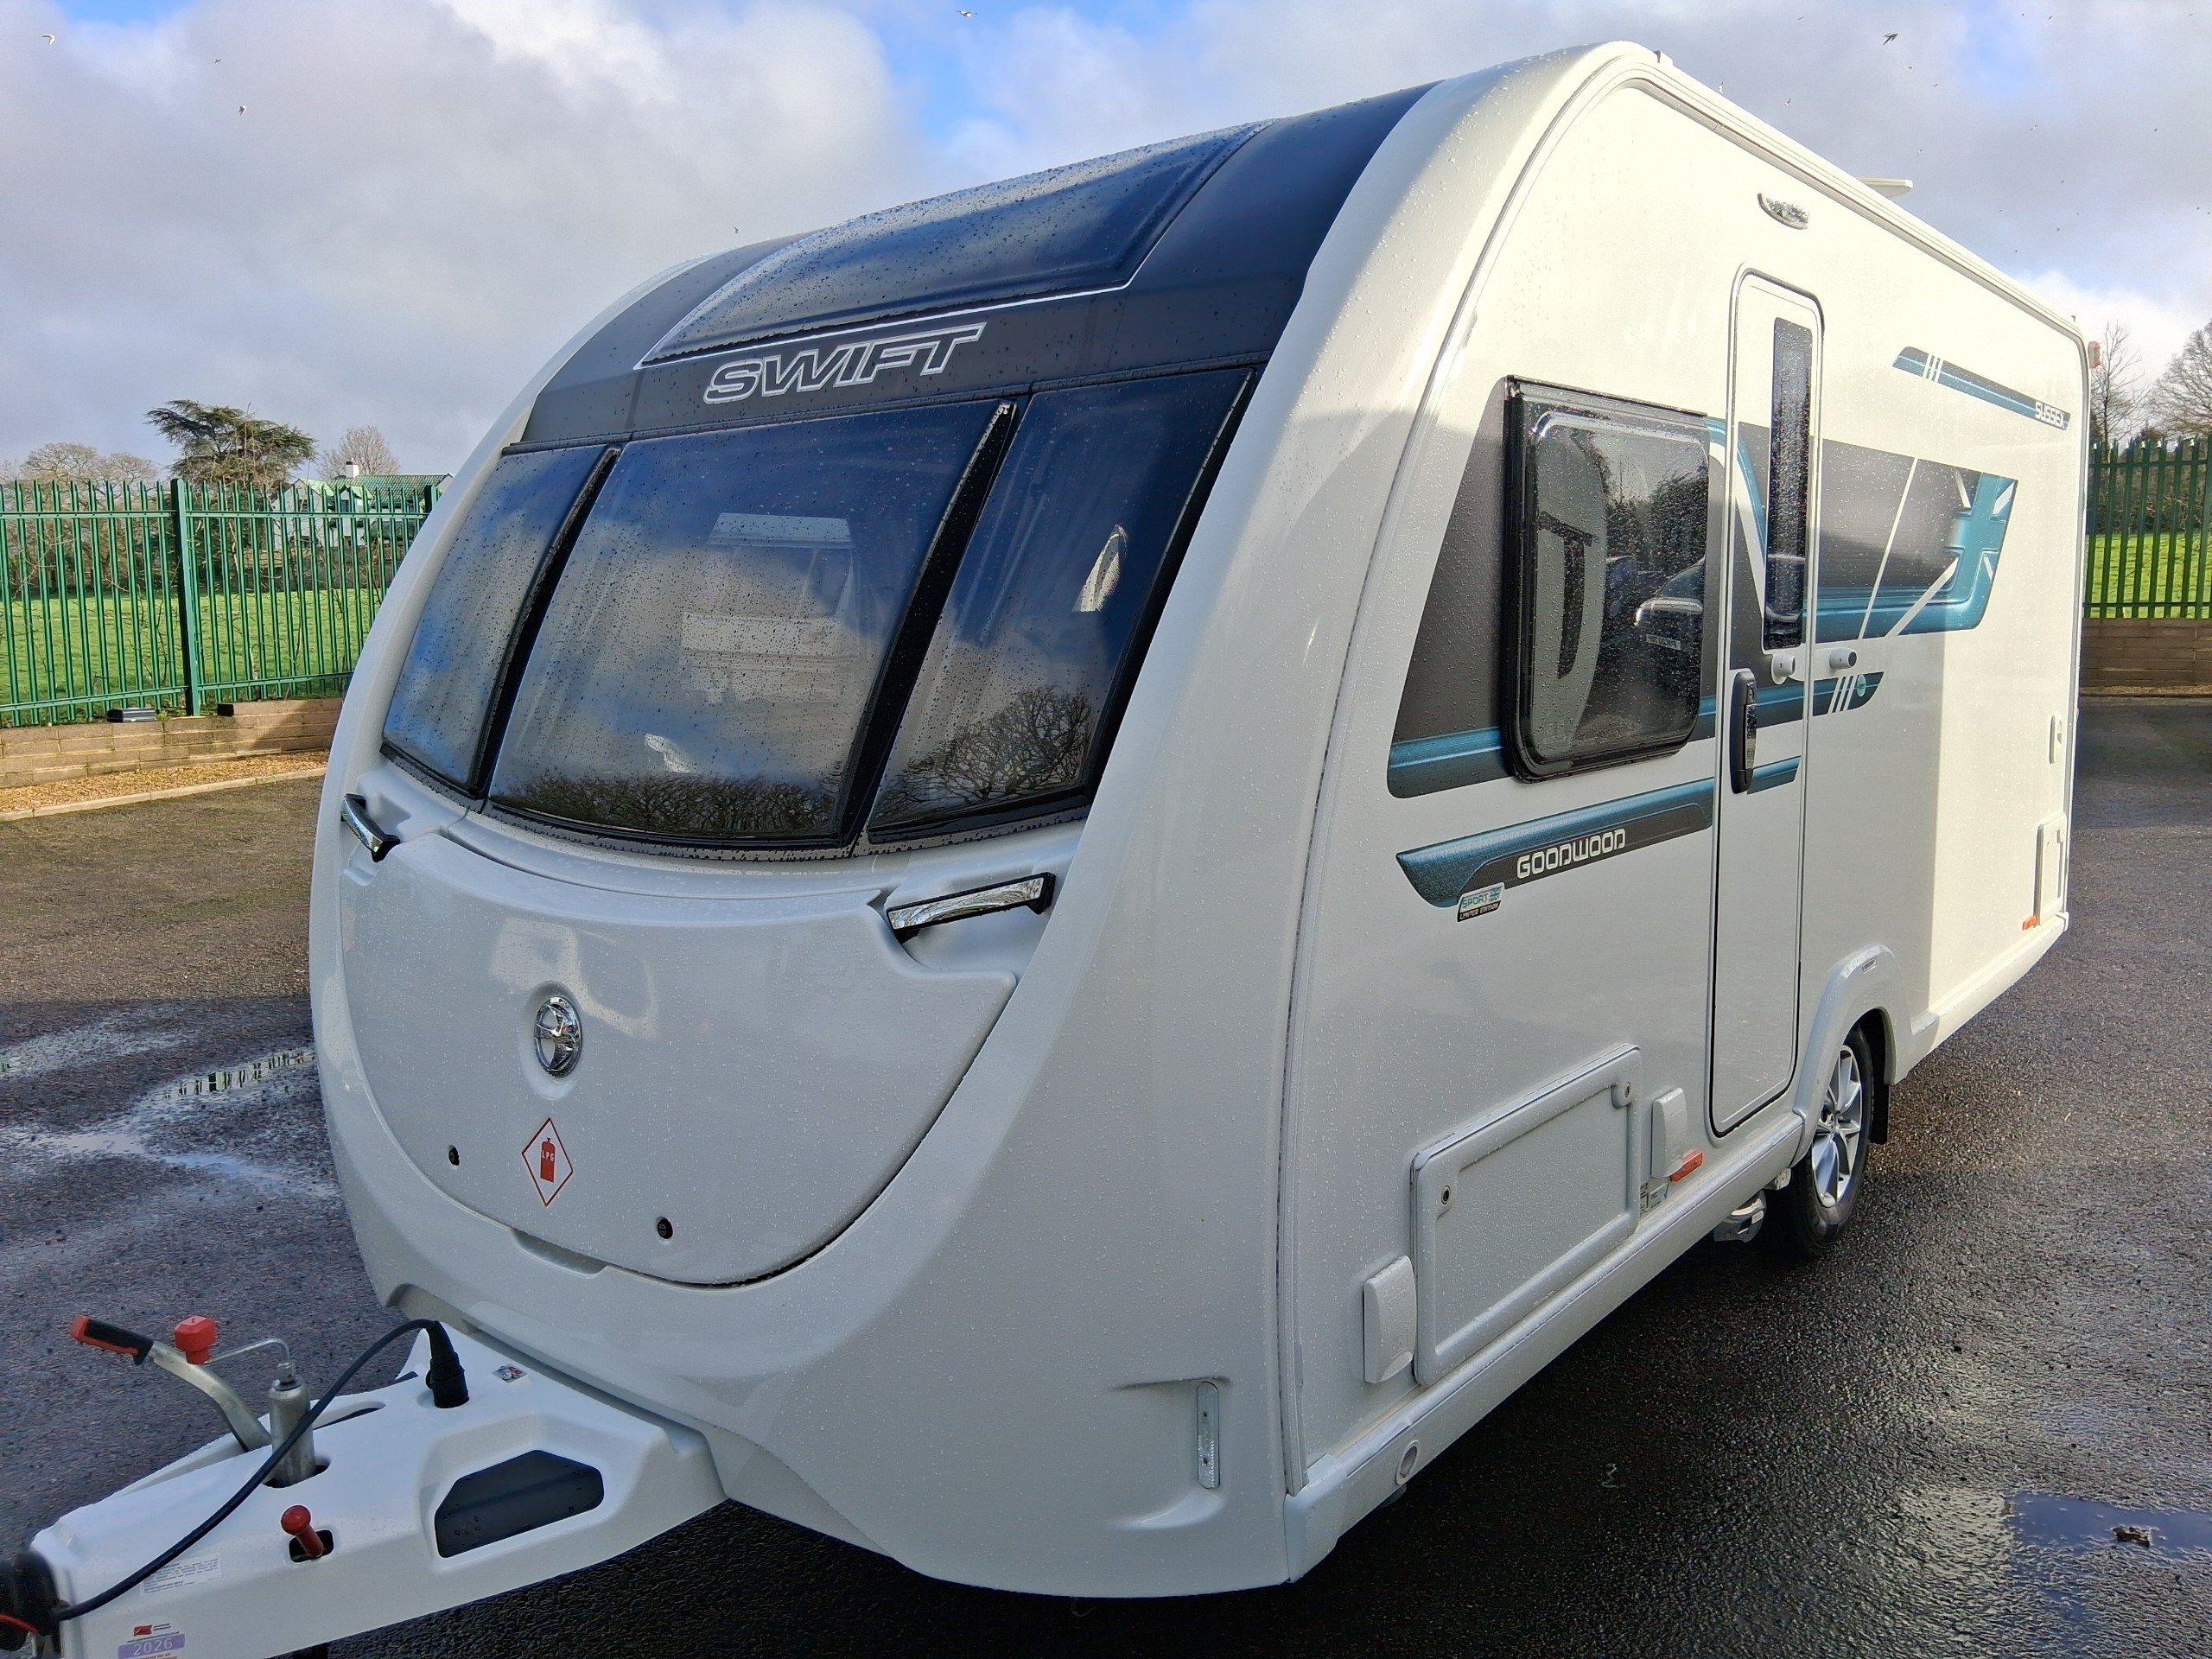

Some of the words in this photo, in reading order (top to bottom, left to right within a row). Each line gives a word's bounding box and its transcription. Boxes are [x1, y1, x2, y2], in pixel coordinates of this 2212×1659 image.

[703, 321, 987, 404] SWIFT
[2035, 401, 2065, 429] SUSSEX
[1516, 828, 1625, 879] GOODWOOD
[1462, 893, 1488, 908] SPORT
[1459, 908, 1478, 920] LIMITED
[1479, 902, 1499, 914] EDITION
[542, 1149, 555, 1162] LPG
[133, 1637, 173, 1656] 2026
